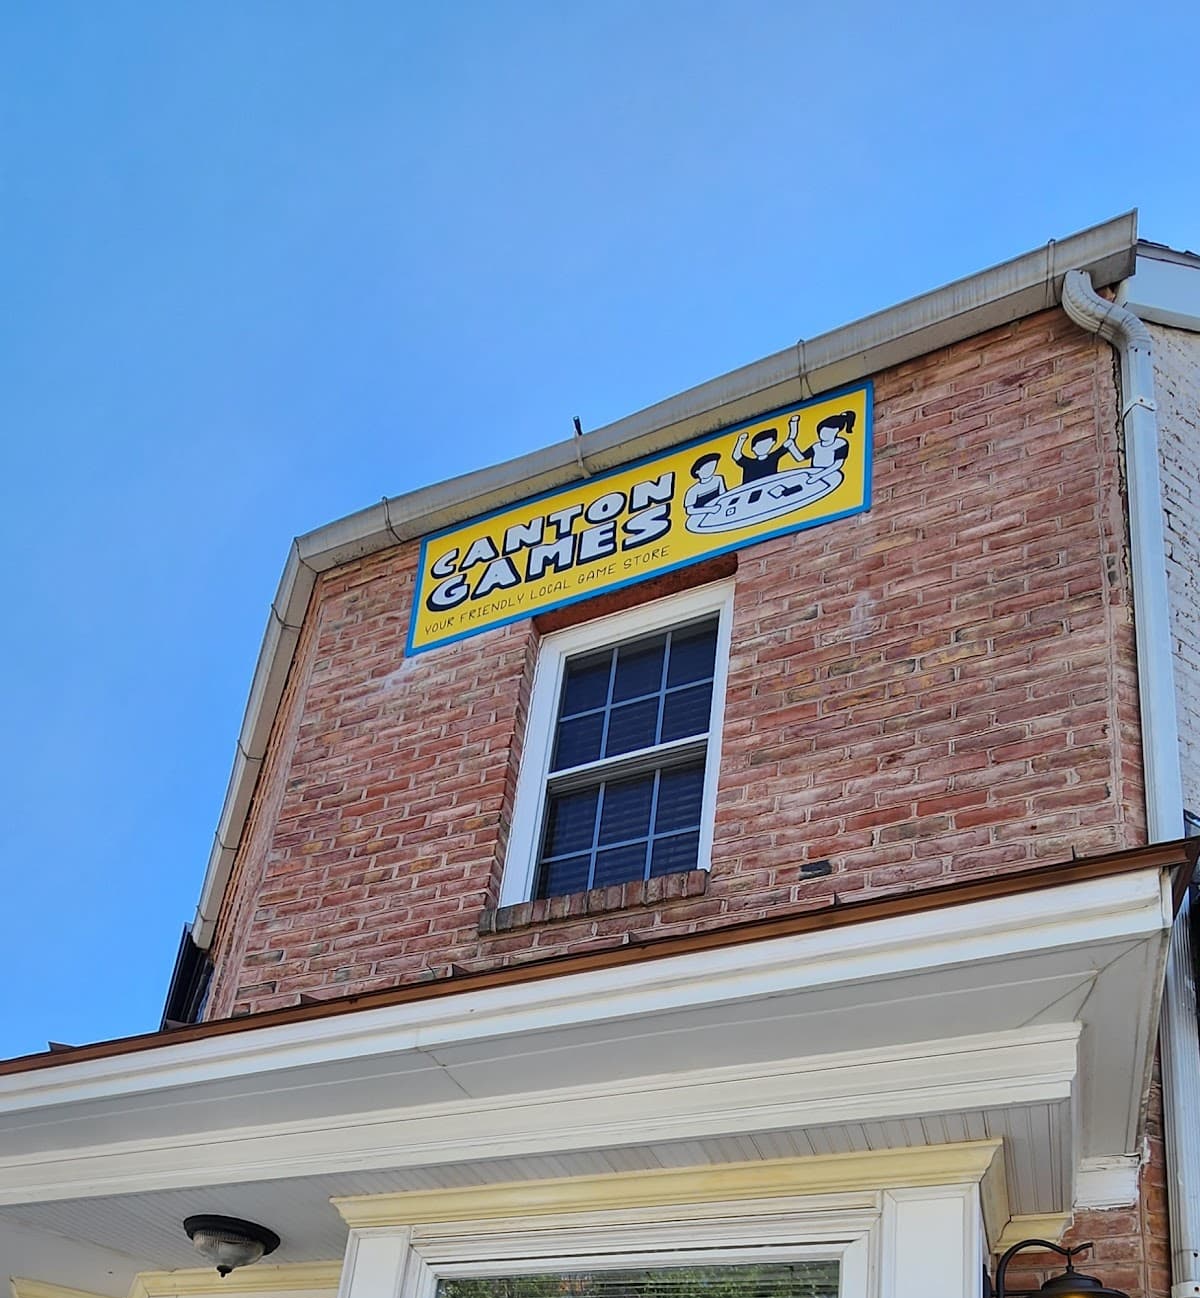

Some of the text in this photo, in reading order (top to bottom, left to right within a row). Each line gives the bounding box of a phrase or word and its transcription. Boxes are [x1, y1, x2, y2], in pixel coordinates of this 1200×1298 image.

[426, 502, 672, 612] GAMES
[430, 472, 675, 579] CANTON
[425, 545, 670, 634] YOUR FRIENDLY LOCAL GAME STORE
